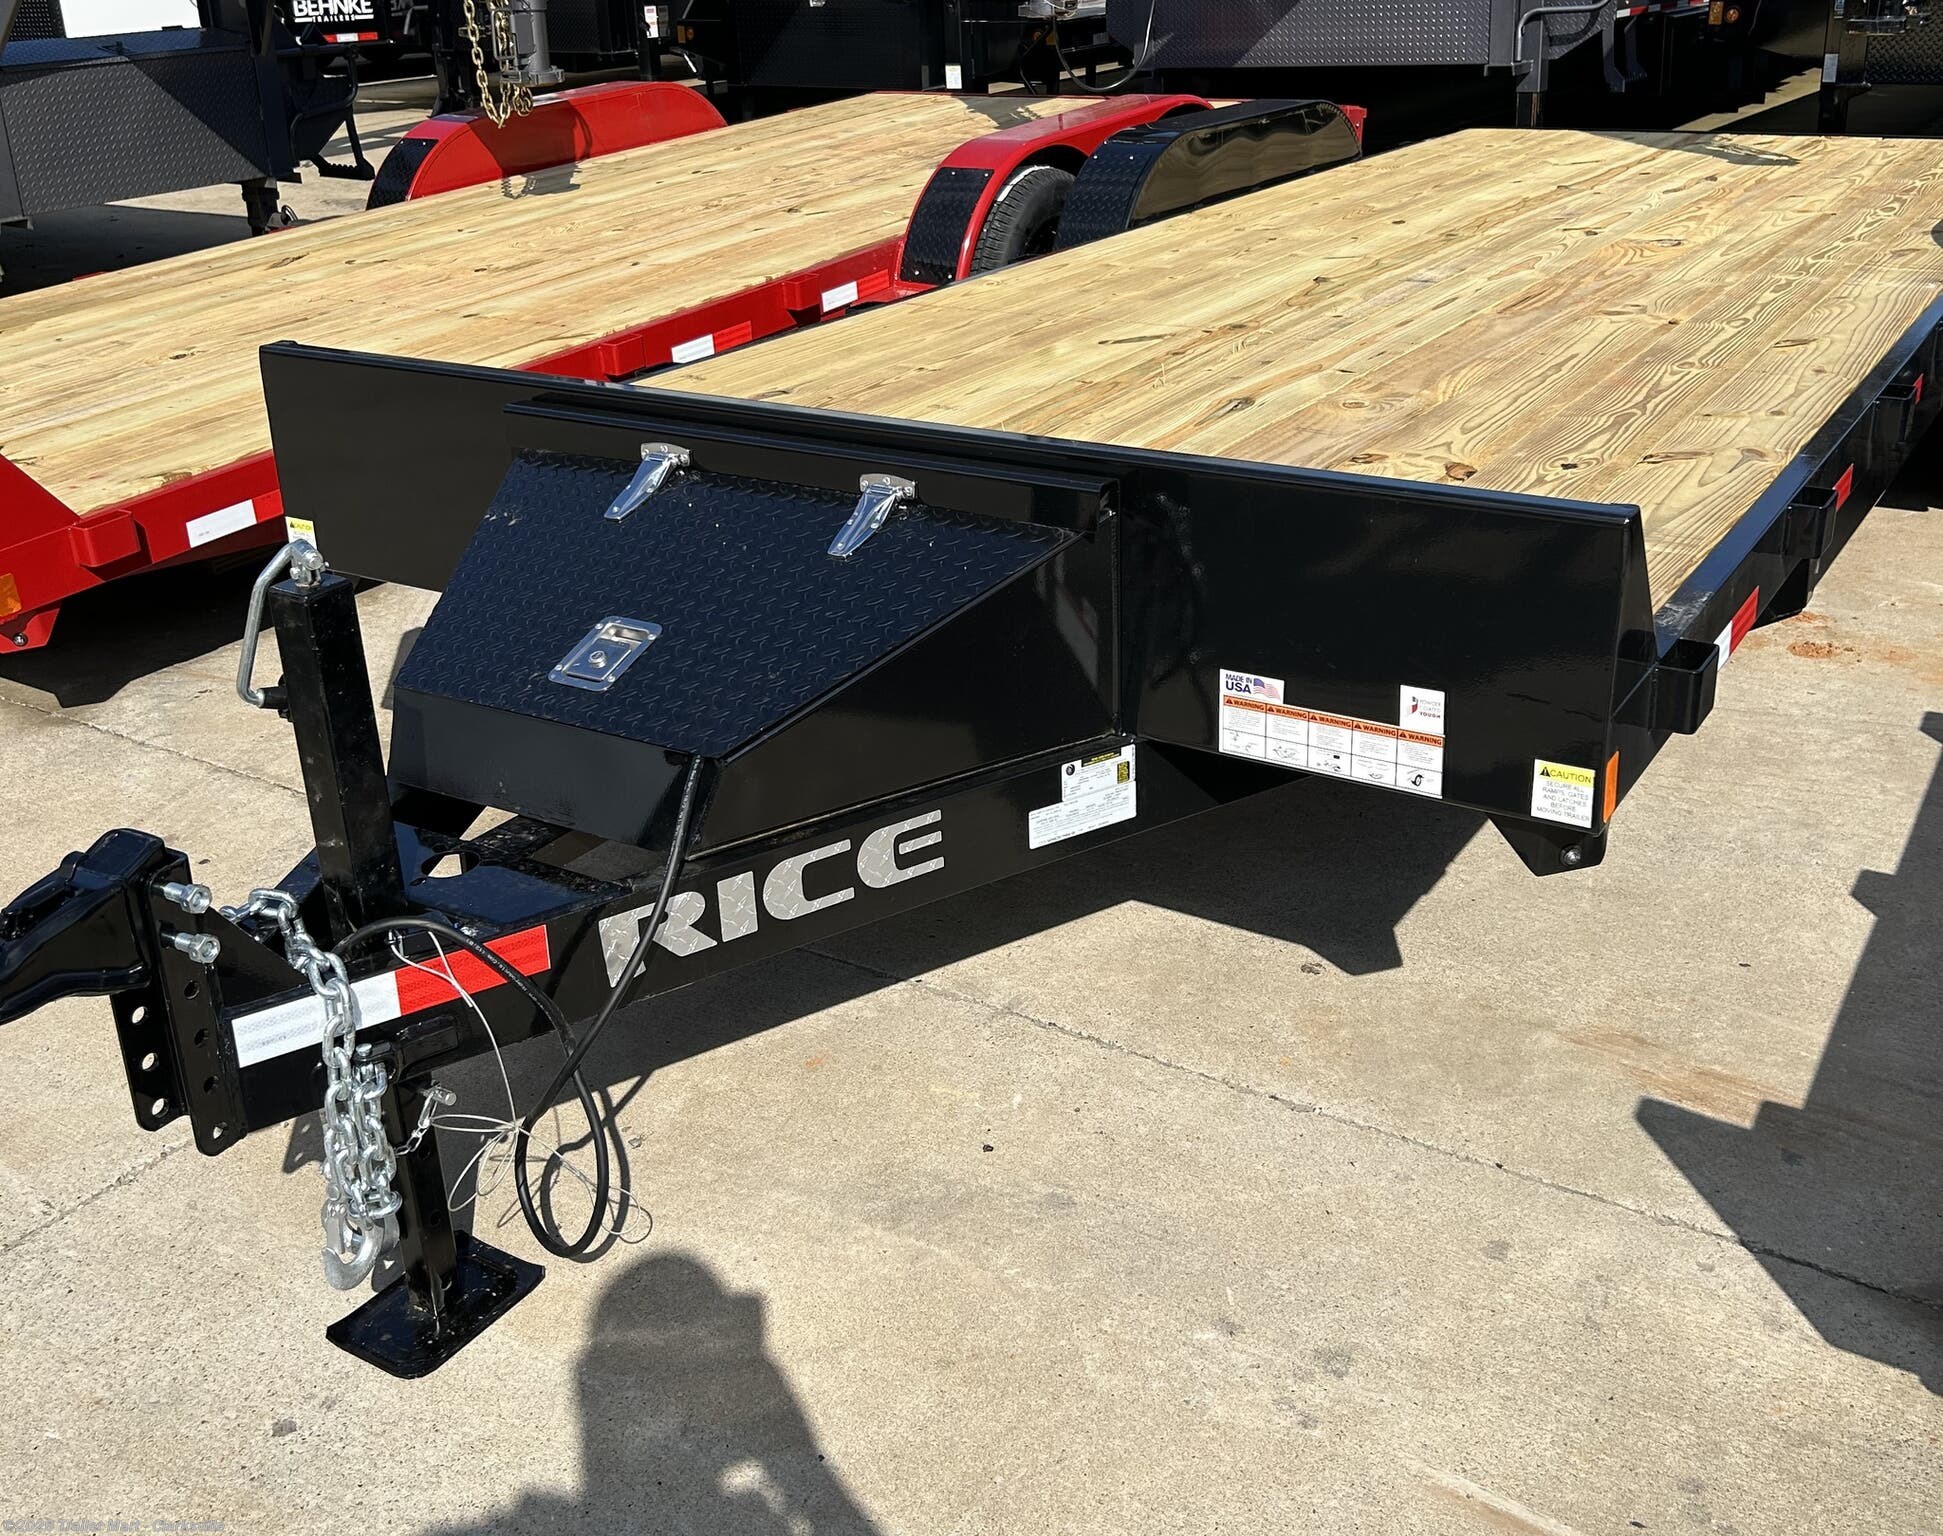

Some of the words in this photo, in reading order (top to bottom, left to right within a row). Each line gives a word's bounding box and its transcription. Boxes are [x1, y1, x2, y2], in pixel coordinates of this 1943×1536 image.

[293, 0, 374, 17] BEHNKE
[312, 15, 356, 23] TRAILERS
[1225, 673, 1244, 683] MADE
[1245, 676, 1253, 684] IN
[1225, 680, 1252, 694] USA
[1233, 700, 1264, 711] WARNING
[1274, 708, 1307, 720] WARNING
[1319, 715, 1351, 728] WARNING
[1362, 724, 1397, 737] WARNING
[1408, 733, 1442, 746] WARNING
[1550, 769, 1591, 783] CAUTION
[1536, 806, 1562, 816] MOVING
[1564, 812, 1589, 821] TRAILER
[597, 809, 945, 988] RICE
